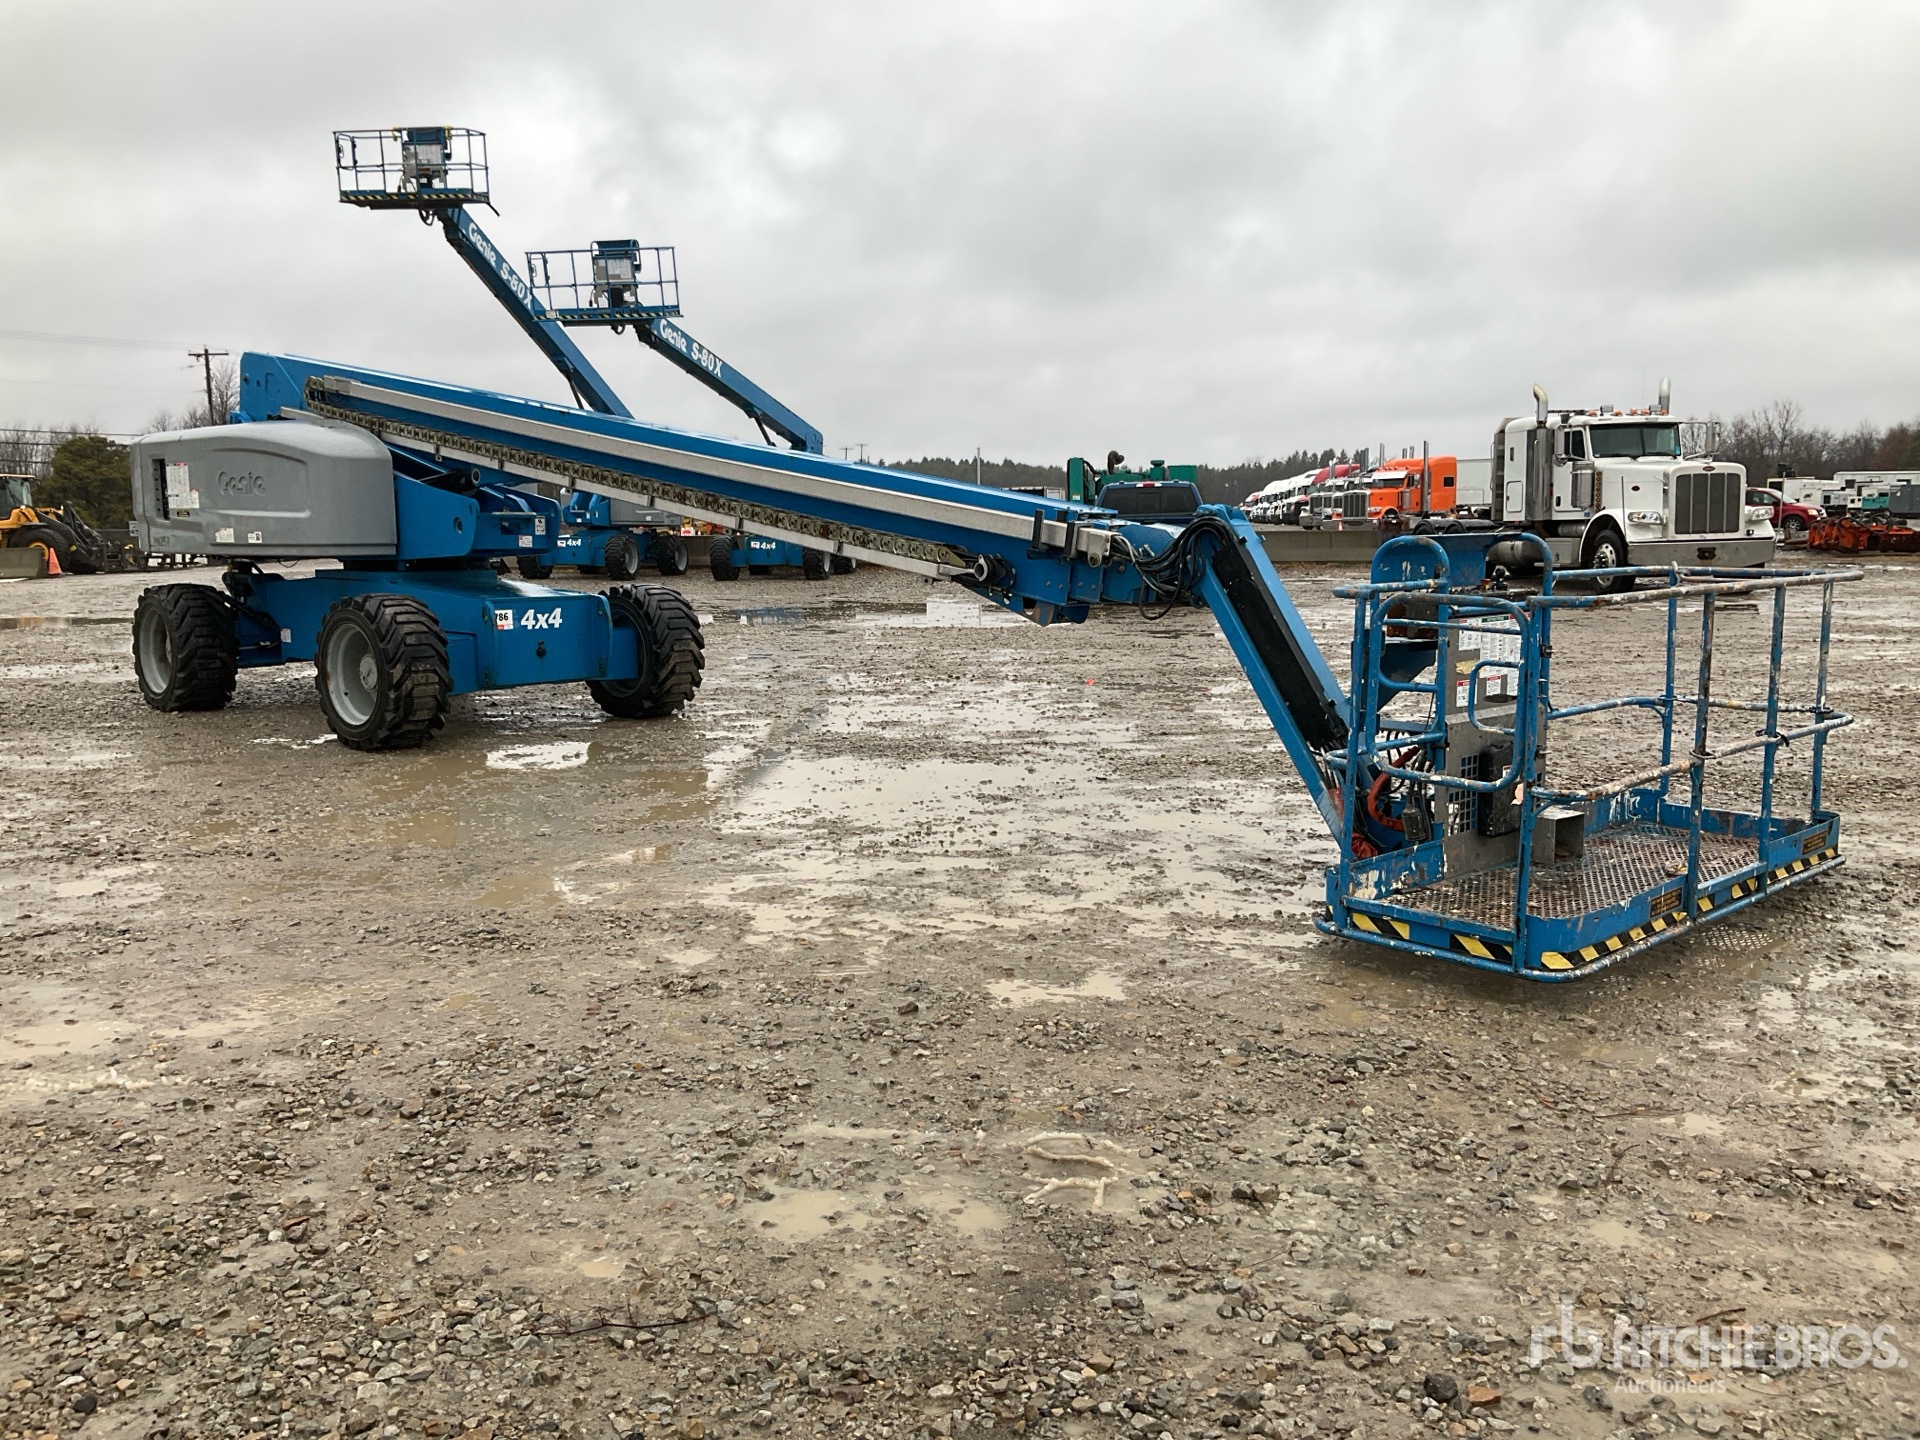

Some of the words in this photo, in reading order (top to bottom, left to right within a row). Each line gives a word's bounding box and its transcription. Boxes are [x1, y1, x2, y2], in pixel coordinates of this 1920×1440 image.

[468, 222, 497, 268] Genie
[660, 319, 687, 353] Genie
[691, 342, 722, 378] S-80X
[218, 470, 266, 496] Genie
[566, 538, 582, 547] 4x4
[760, 541, 776, 550] 4x4
[520, 607, 563, 630] 4x4
